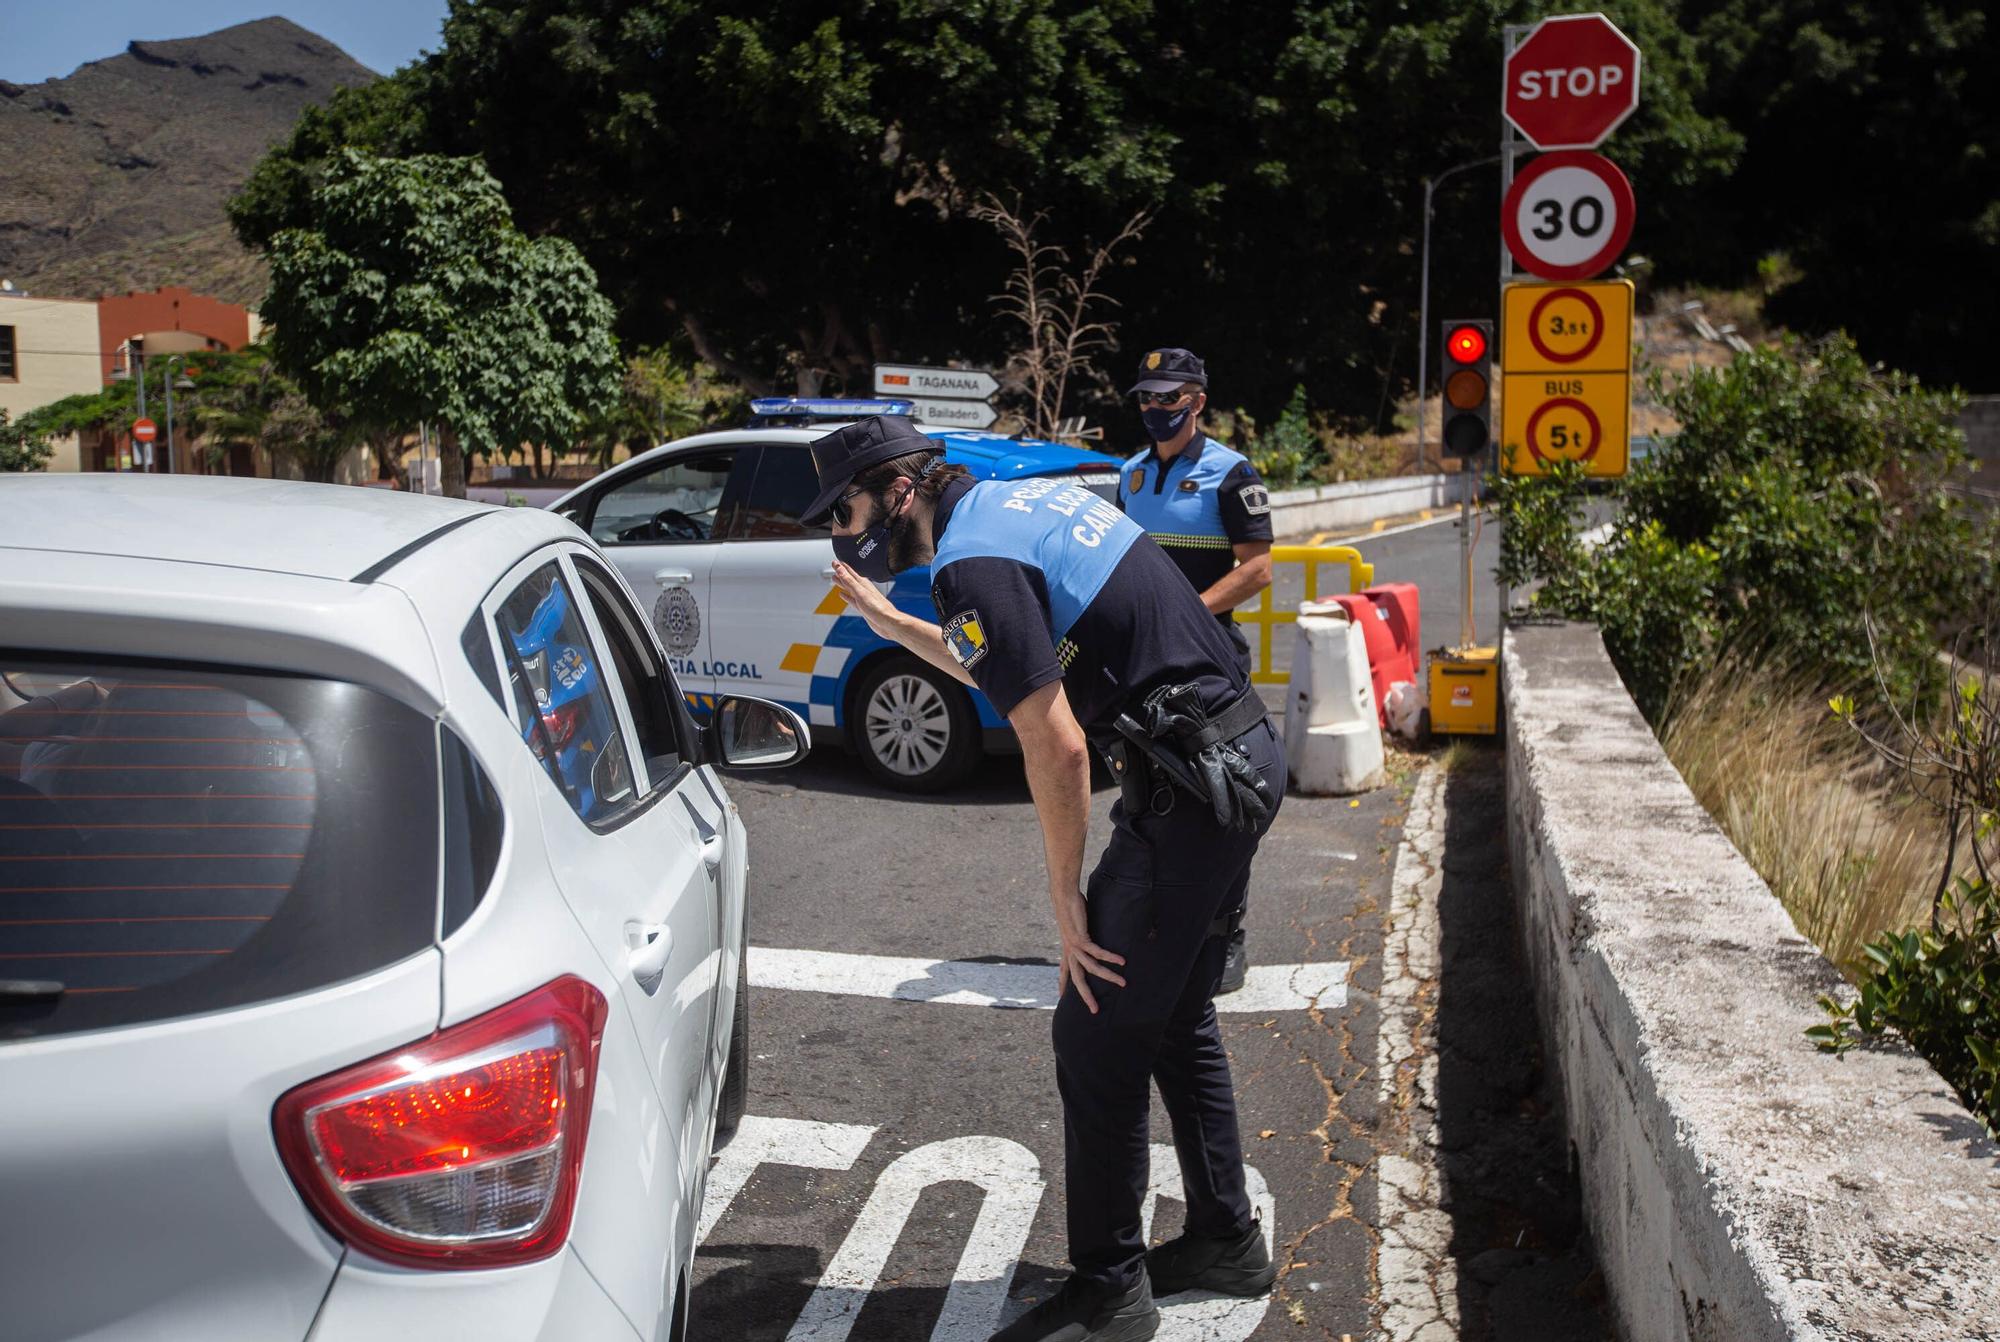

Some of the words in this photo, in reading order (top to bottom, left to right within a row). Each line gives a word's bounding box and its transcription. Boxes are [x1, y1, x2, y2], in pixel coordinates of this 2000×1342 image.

[1517, 64, 1623, 101] STOP
[1532, 195, 1604, 240] 30
[1580, 320, 1588, 335] t
[916, 376, 980, 390] TAGANANA
[1545, 380, 1583, 395] BUS
[928, 406, 980, 420] Bailadero
[1550, 425, 1568, 449] 5
[1573, 430, 1582, 448] t
[963, 648, 985, 668] CANARIA
[703, 661, 762, 680] LOCAL
